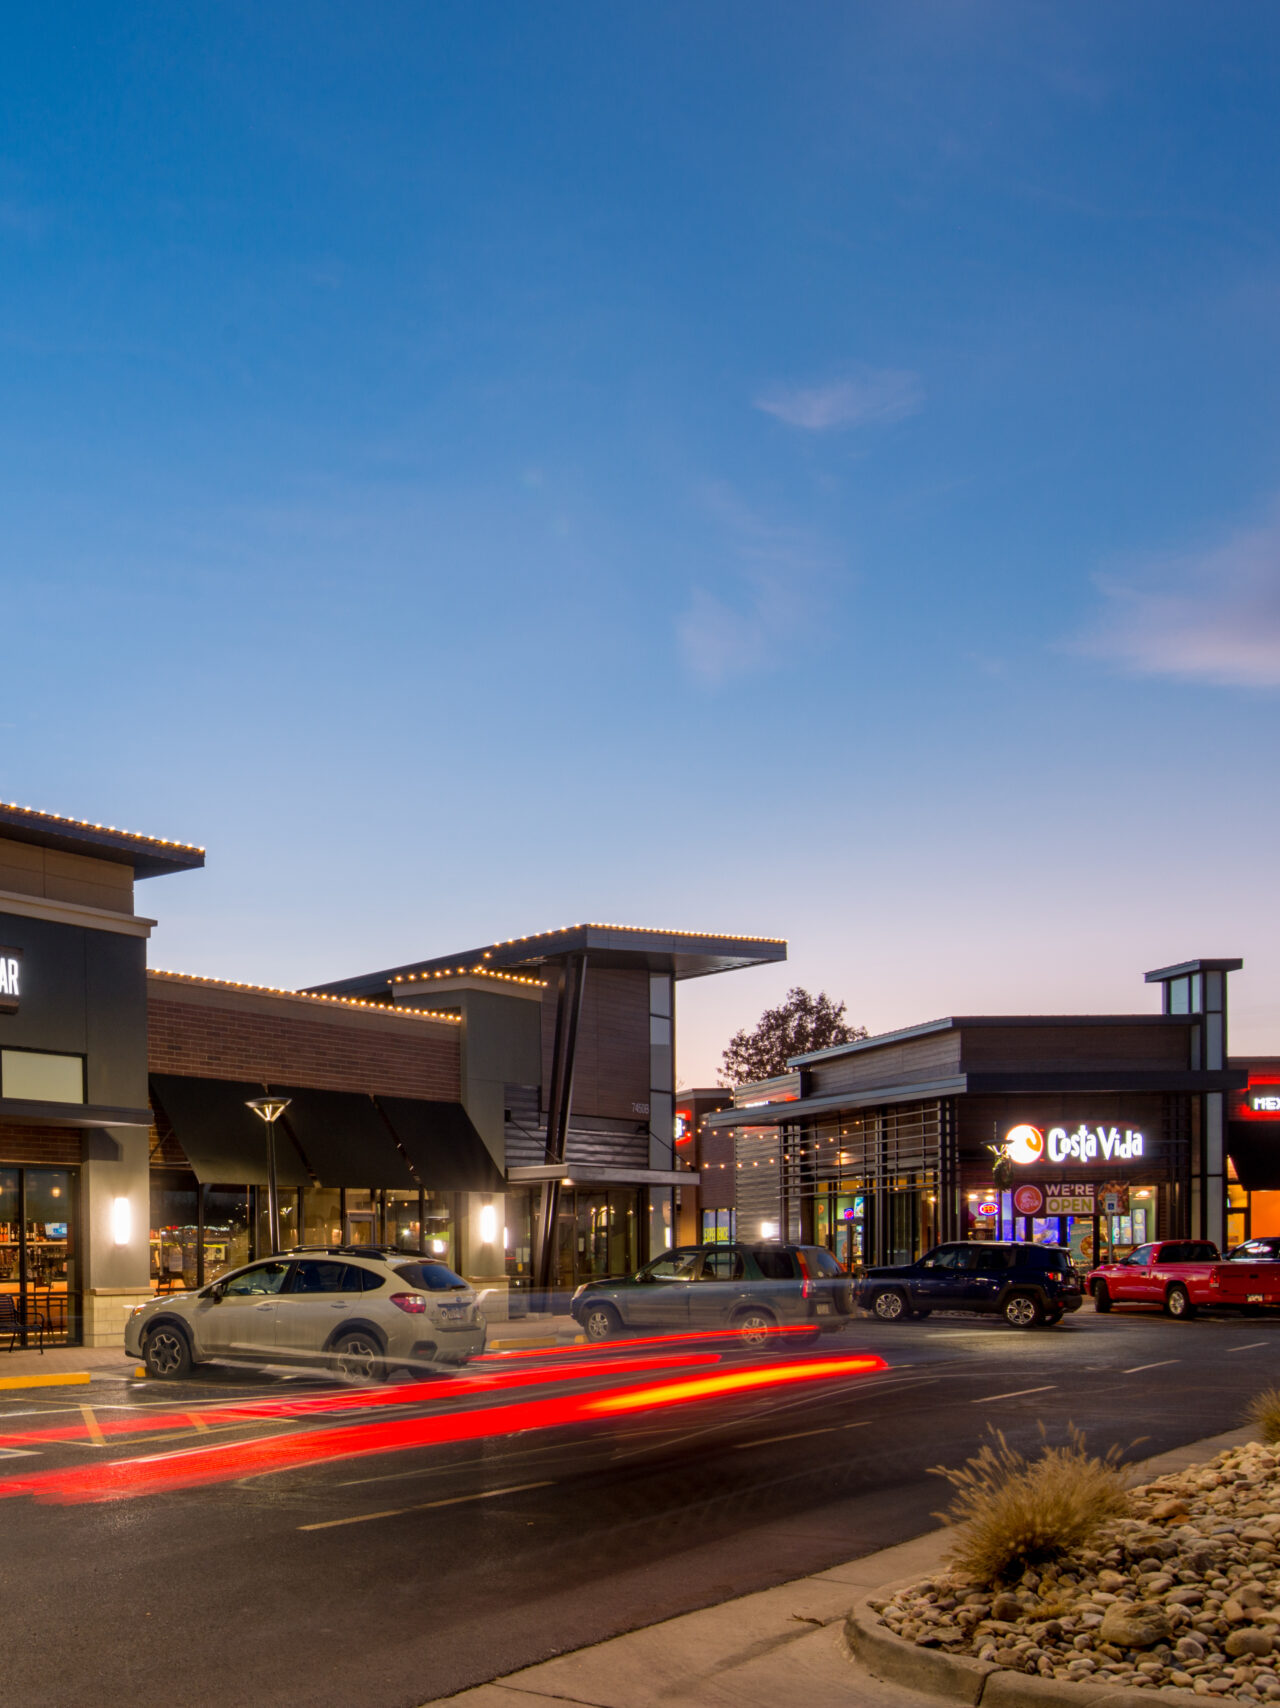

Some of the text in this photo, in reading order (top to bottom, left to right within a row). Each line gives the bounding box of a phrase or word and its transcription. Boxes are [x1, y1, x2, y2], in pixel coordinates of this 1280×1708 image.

[1047, 1124, 1144, 1163] Costa Vida
[1045, 1183, 1094, 1196] WE'RE
[1048, 1200, 1091, 1212] OPEN
